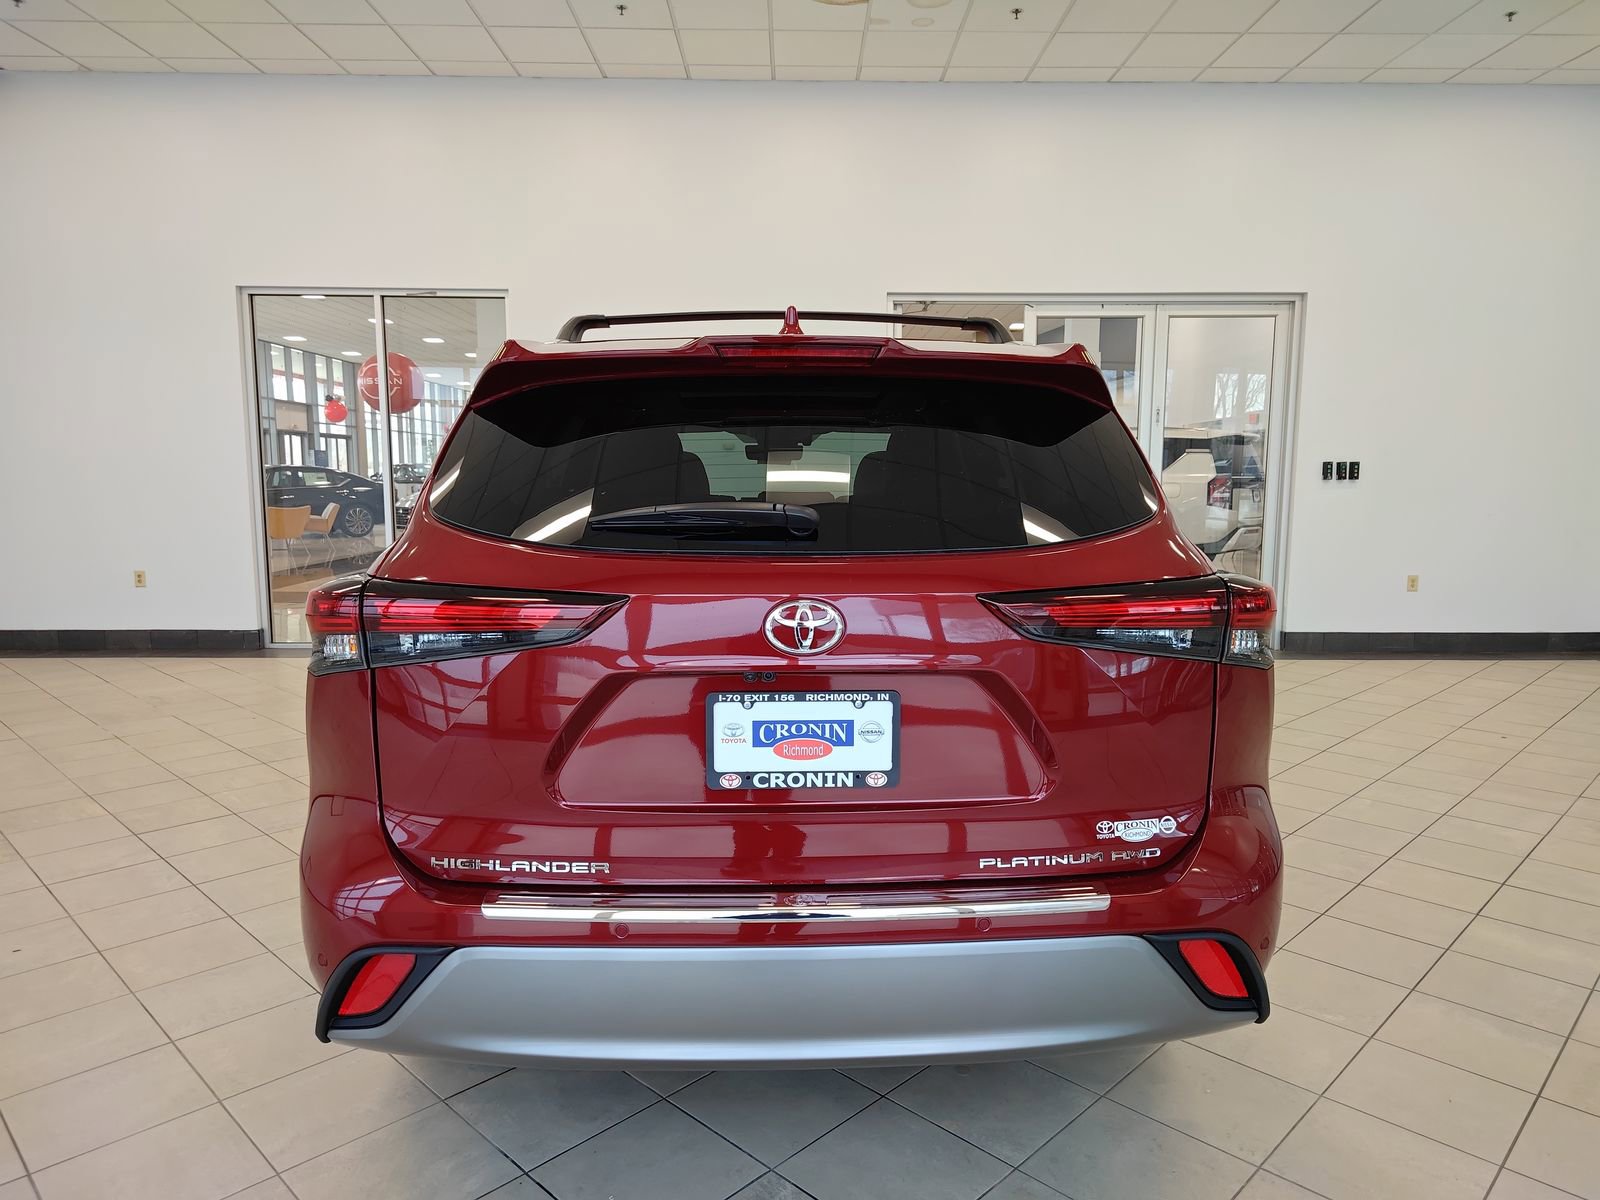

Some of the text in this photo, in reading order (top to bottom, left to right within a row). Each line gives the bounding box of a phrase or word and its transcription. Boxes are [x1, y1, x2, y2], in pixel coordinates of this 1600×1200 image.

[718, 693, 890, 702] I-70 EXIT 156 RICHMOND, IN
[759, 722, 848, 744] CRONIN
[783, 744, 824, 757] Richmond
[752, 772, 854, 788] CRONIN
[1115, 820, 1158, 833] CRONIN
[1124, 830, 1152, 838] RICHMOND
[430, 856, 610, 874] HIGHLANDER
[979, 847, 1161, 869] PLATINUM AWD
